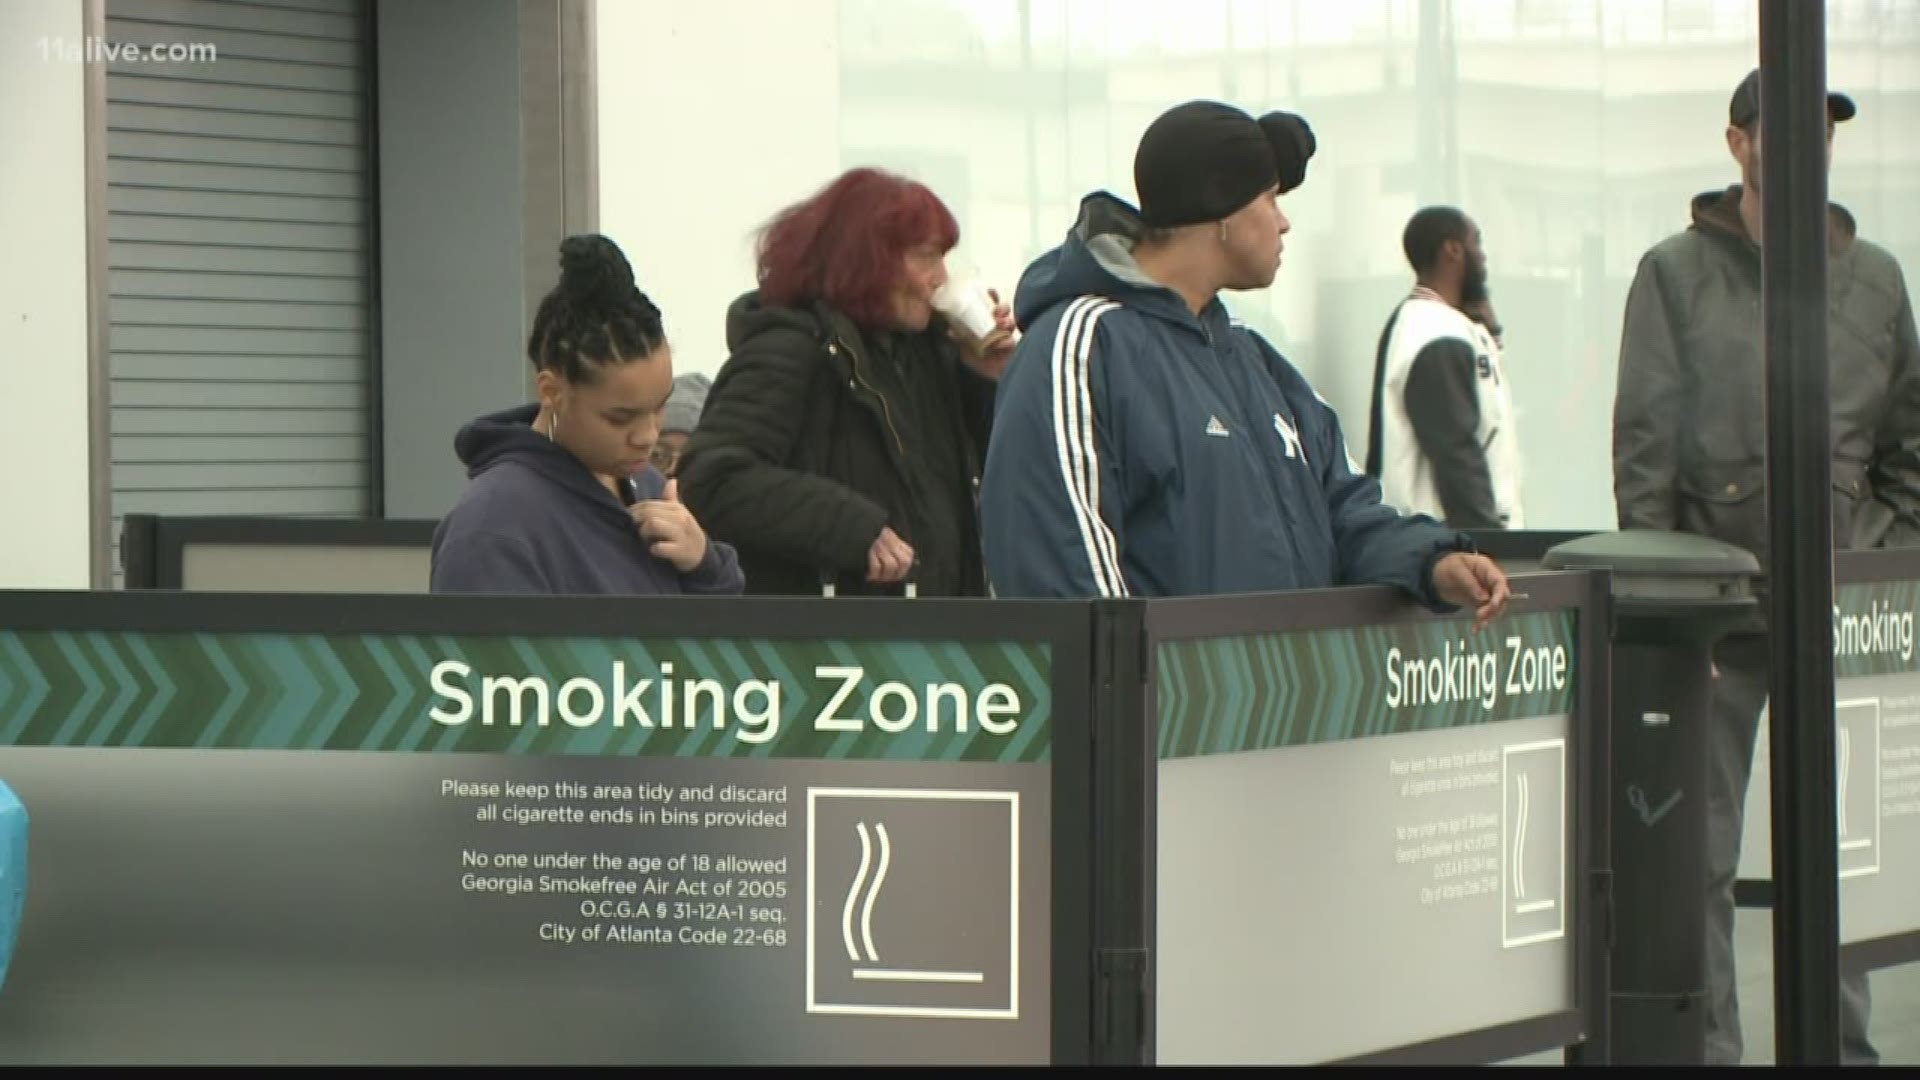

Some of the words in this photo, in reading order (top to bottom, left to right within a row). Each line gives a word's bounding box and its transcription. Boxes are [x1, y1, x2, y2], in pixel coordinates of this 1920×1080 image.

[1386, 640, 1498, 710] Smoking
[1505, 636, 1568, 696] Zone
[427, 660, 783, 744] Smoking
[814, 665, 1022, 734] Zone
[441, 779, 500, 799] Please
[505, 780, 550, 803] keep
[554, 780, 588, 799] this
[593, 784, 633, 800] area
[638, 782, 674, 804] tidy
[678, 783, 713, 802] and
[719, 784, 787, 803] discard
[476, 803, 497, 821] all
[502, 804, 585, 826] cigarette
[589, 806, 634, 824] ends
[639, 806, 656, 824] in
[661, 807, 699, 826] bins
[704, 809, 787, 829] provided
[462, 850, 488, 867] No
[493, 853, 529, 868] one
[533, 851, 587, 869] under
[592, 852, 623, 870] the
[627, 857, 662, 874] age
[666, 853, 687, 871] of
[691, 854, 711, 872] 18
[715, 854, 787, 874] allowed
[461, 872, 534, 895] Georgia
[539, 875, 637, 894] Smokefree
[642, 877, 670, 895] Air
[675, 878, 708, 896] Act
[713, 879, 733, 896] of
[737, 880, 787, 898] 2005
[580, 900, 651, 918] O.C.G.A
[673, 903, 744, 920] 31-12A-1
[750, 908, 787, 925] seq.
[540, 923, 576, 944] City
[582, 923, 601, 942] of
[605, 924, 673, 943] Atlanta
[679, 925, 728, 943] Code
[734, 928, 787, 946] 22-68
